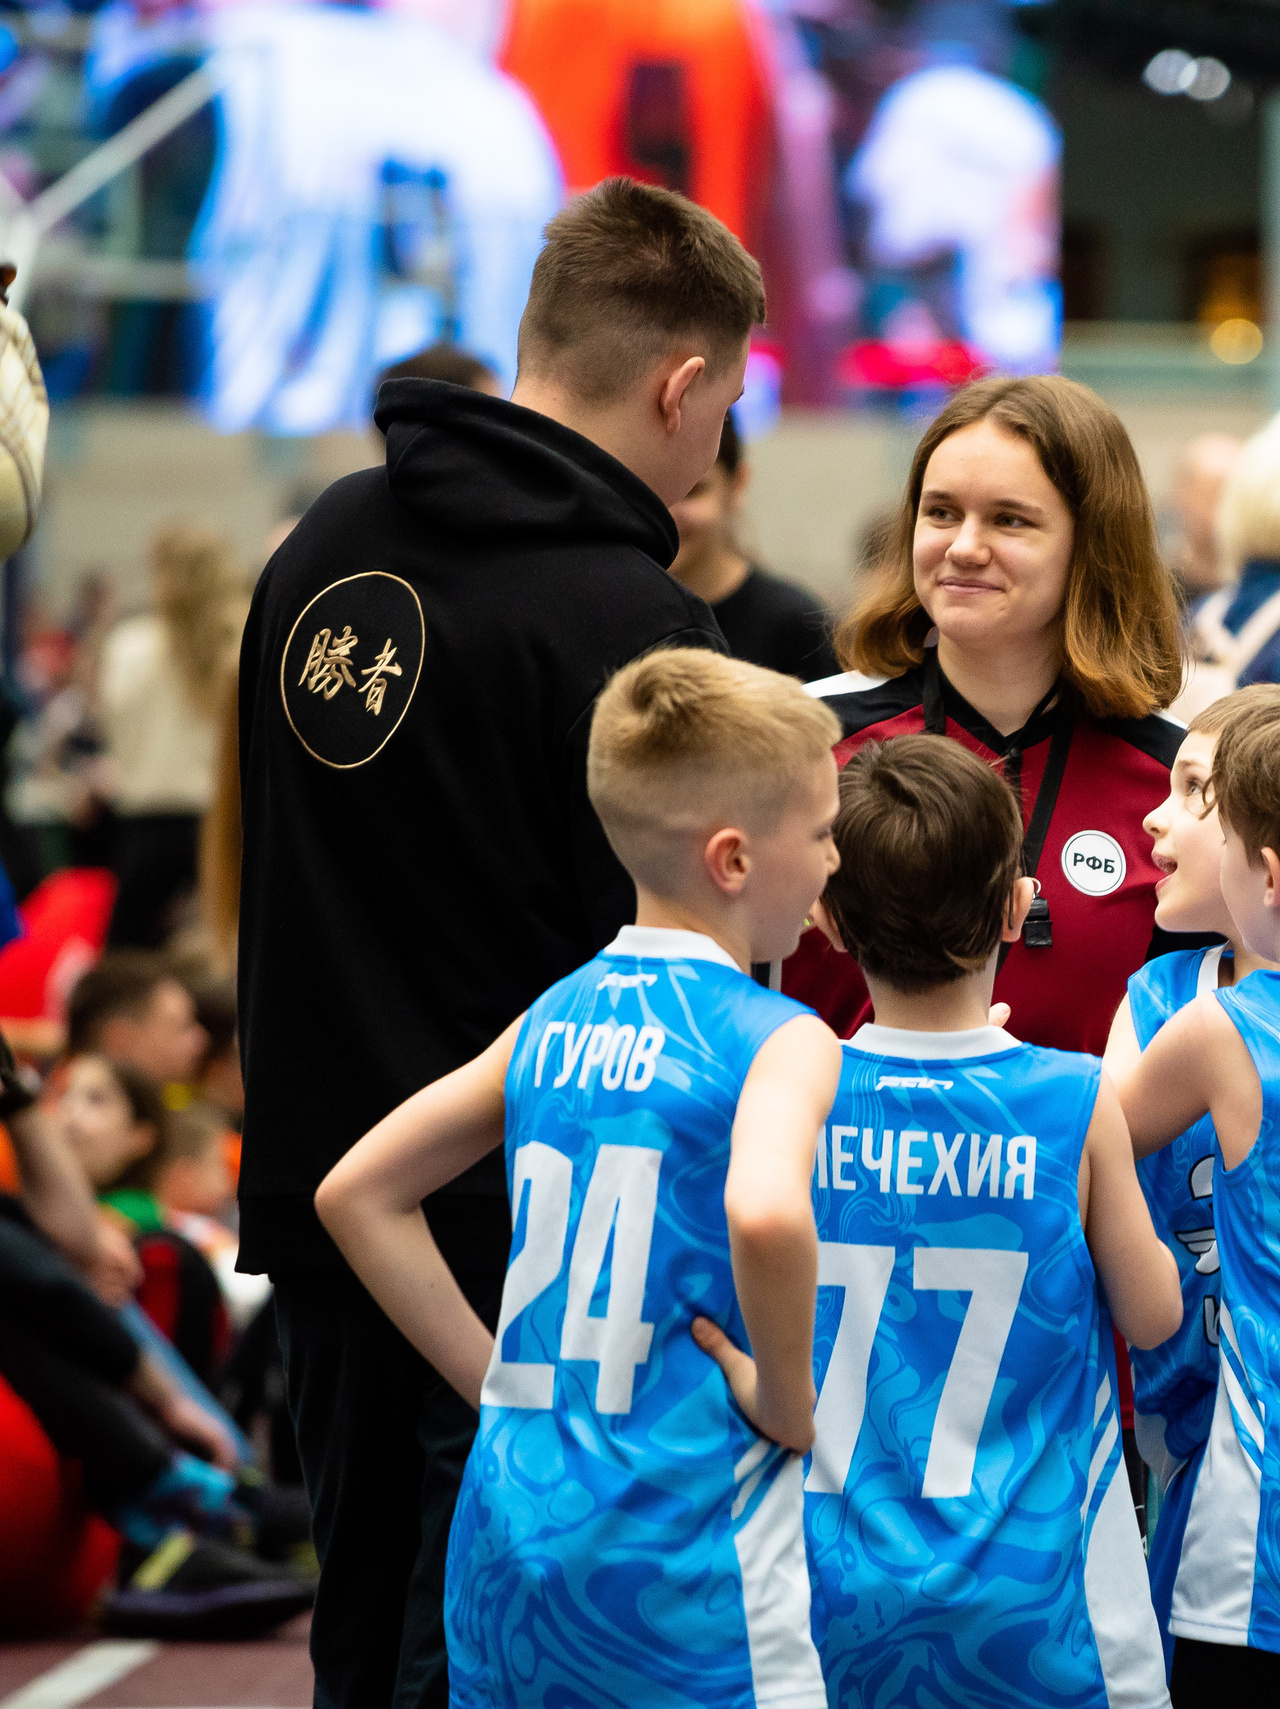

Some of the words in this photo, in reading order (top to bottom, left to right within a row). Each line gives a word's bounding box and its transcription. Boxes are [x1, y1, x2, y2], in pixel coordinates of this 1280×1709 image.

[297, 625, 403, 716] 勝者
[1072, 852, 1116, 874] РФБ
[534, 1020, 667, 1092] ГУРОВ
[480, 1140, 664, 1415] 24
[803, 1241, 1030, 1499] 77
